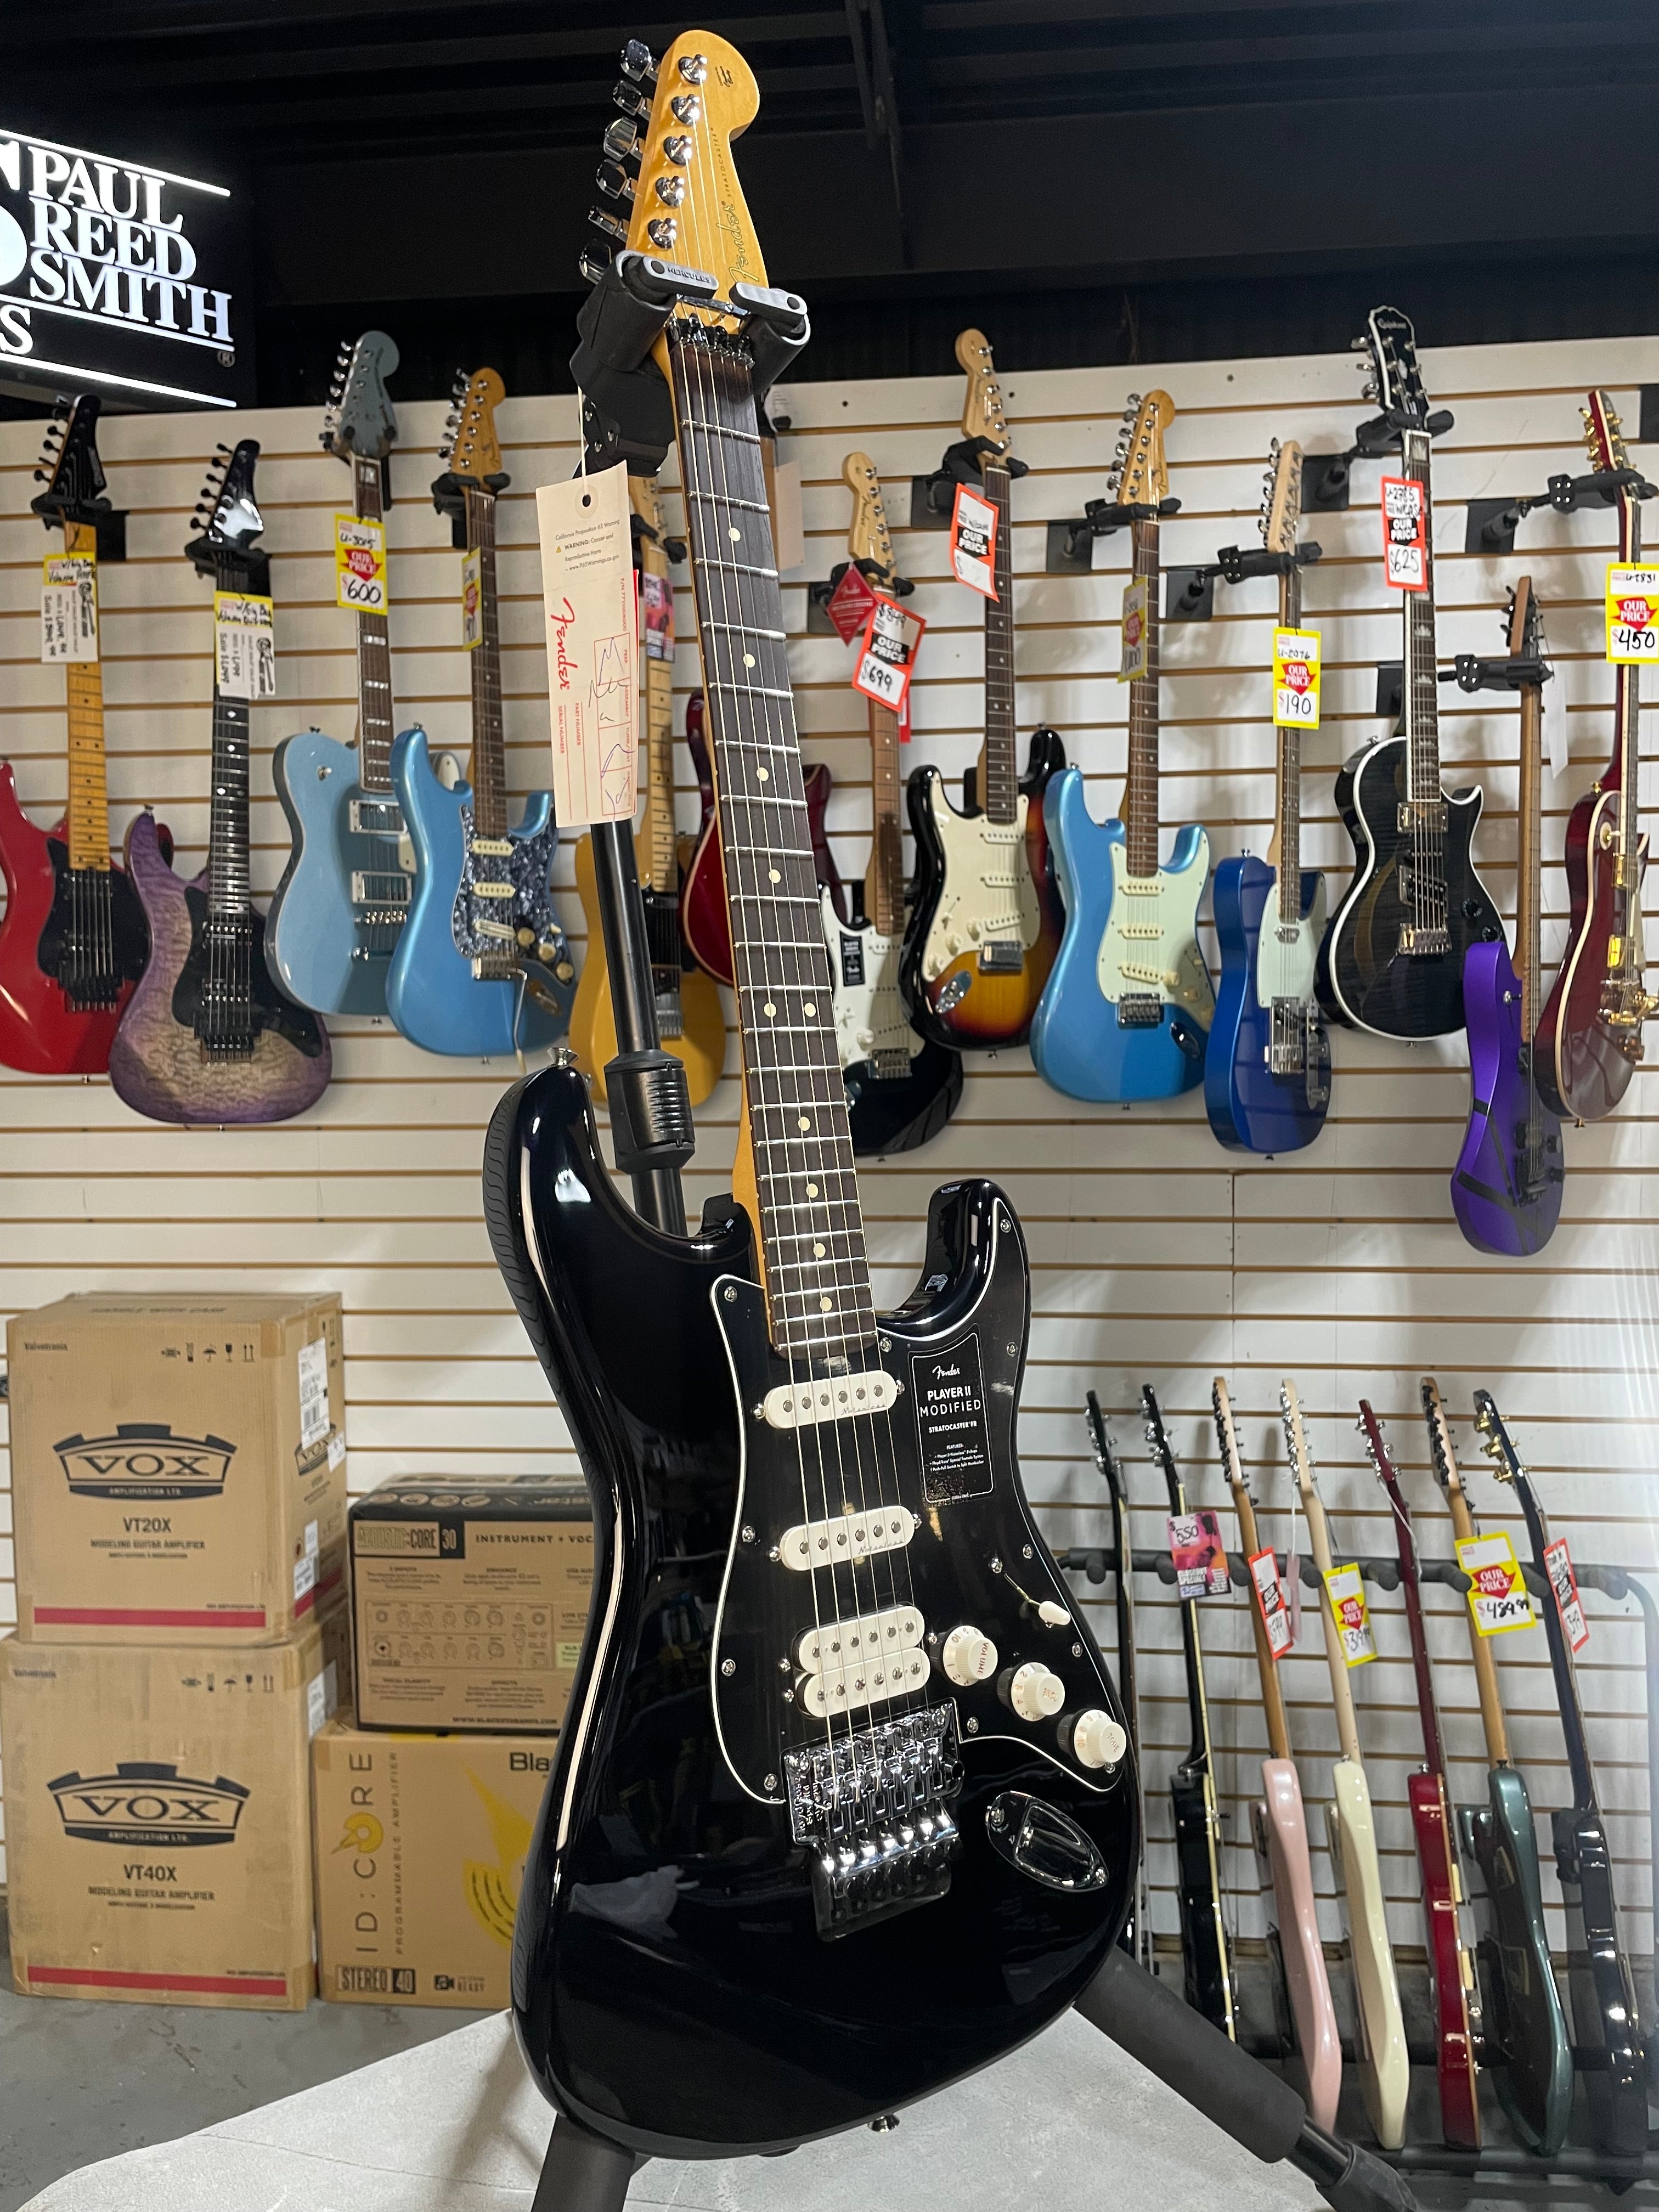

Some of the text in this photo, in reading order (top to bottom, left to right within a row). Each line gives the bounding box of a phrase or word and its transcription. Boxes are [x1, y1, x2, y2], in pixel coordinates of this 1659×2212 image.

[27, 145, 184, 233] PAUL
[29, 196, 197, 281] REED
[716, 204, 759, 283] Fender
[667, 267, 710, 284] HERCULES
[29, 250, 234, 343] SMITH
[1392, 518, 1413, 531] OUR
[962, 528, 984, 544] OUR
[1391, 527, 1418, 541] PRICE
[565, 540, 590, 550] WARNING:
[958, 538, 988, 555] PRICE
[351, 550, 373, 562] OUR
[1390, 549, 1419, 574] $625
[348, 561, 377, 574] PRICE
[1623, 600, 1646, 612] OUR
[1620, 610, 1650, 623] PRICE
[551, 597, 578, 686] Fender
[877, 636, 902, 652] OUR
[871, 644, 906, 664] PRICE
[862, 660, 892, 693] $699
[1288, 664, 1308, 676] OUR
[1285, 674, 1311, 687] PRICE
[932, 1363, 960, 1380] Fender
[927, 1385, 972, 1401] PLAYER II
[920, 1400, 981, 1417] MODIFIED
[78, 1453, 210, 1476] VOX
[123, 1516, 172, 1533] VT20X
[442, 1528, 458, 1550] 30
[476, 1534, 553, 1544] INSTRUMENT
[1480, 1568, 1504, 1582] OUR
[1479, 1576, 1510, 1592] PRICE
[1343, 1600, 1359, 1614] OUR
[1344, 1608, 1362, 1624] PRICE
[977, 1642, 989, 1675] VOLUME
[1108, 1733, 1120, 1752] TONE
[72, 1795, 221, 1822] VOX
[390, 1751, 404, 1956] PROGRAMMABLE AMPLIFIER
[123, 1863, 177, 1882] VT40X
[341, 1966, 414, 1993] STEREO 40
